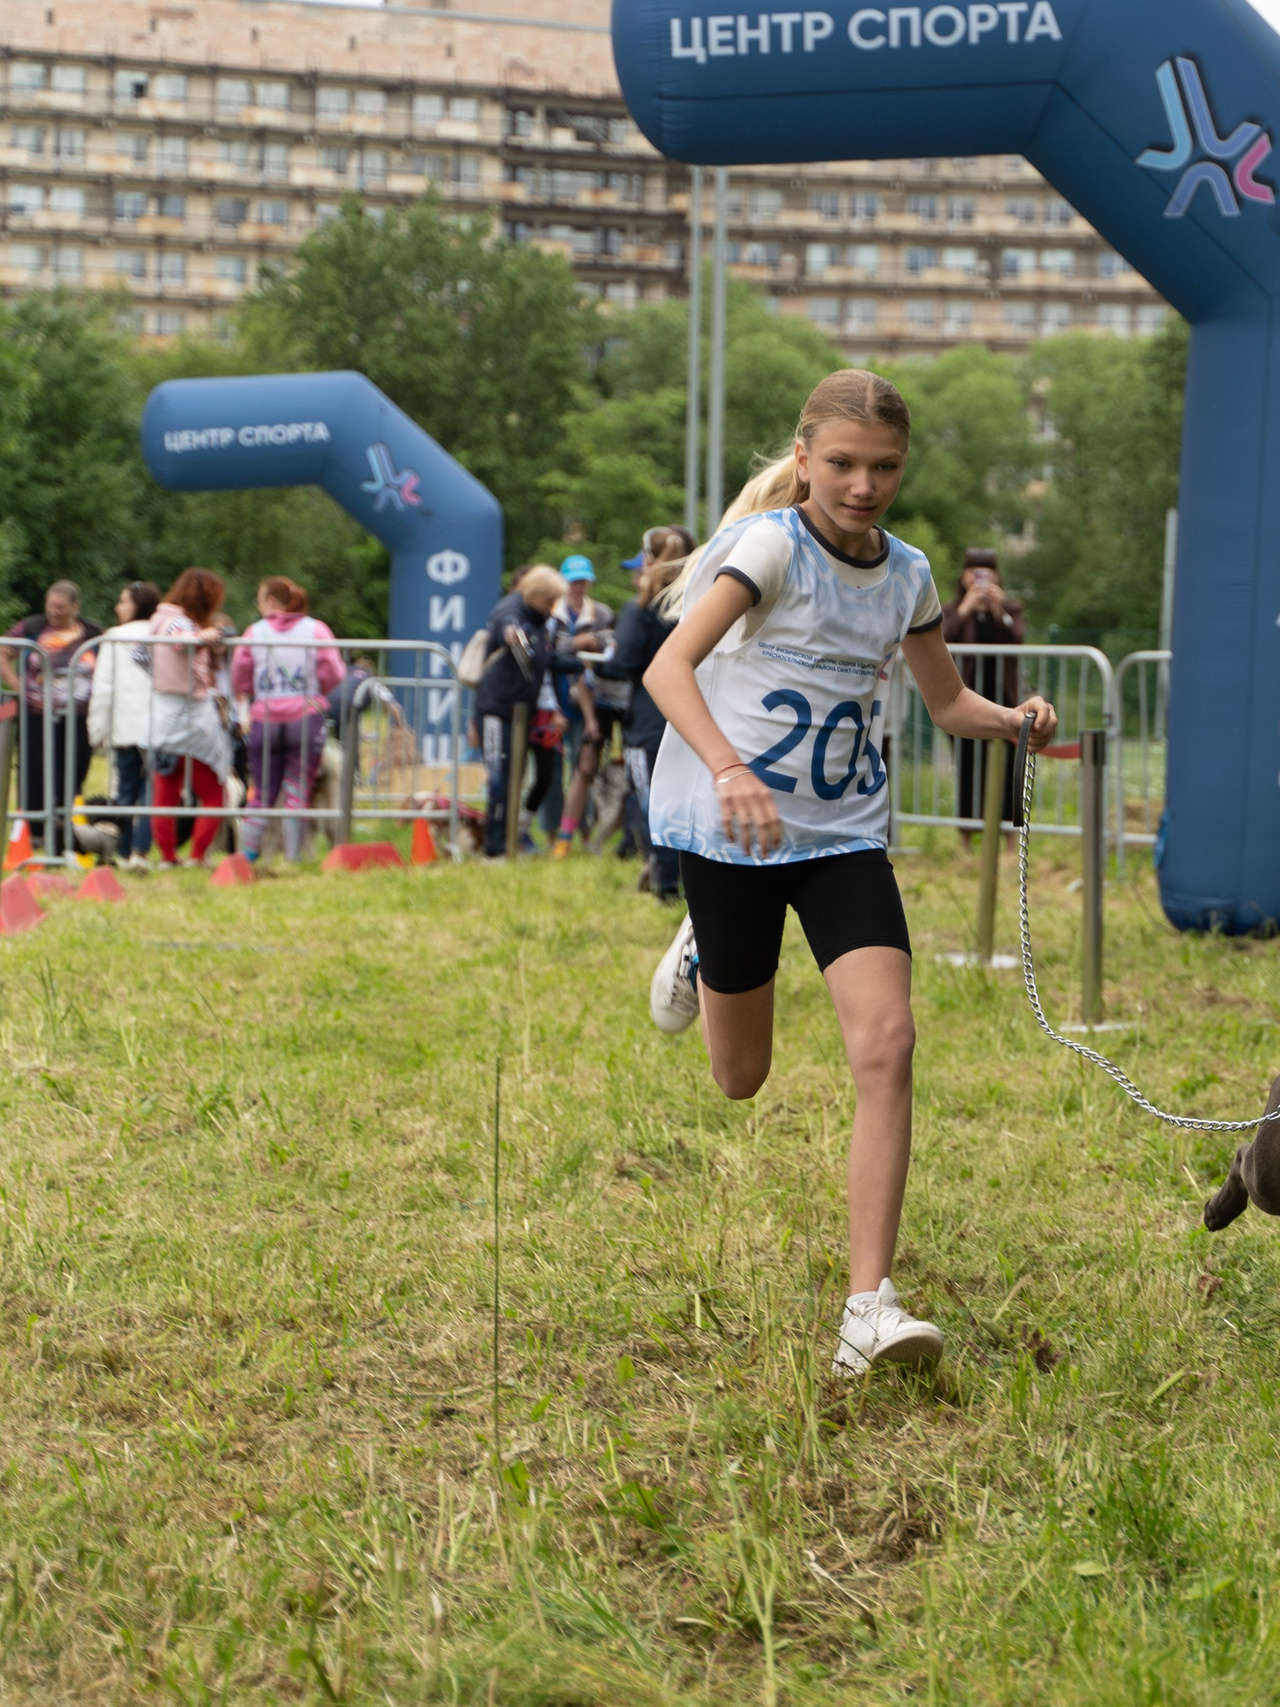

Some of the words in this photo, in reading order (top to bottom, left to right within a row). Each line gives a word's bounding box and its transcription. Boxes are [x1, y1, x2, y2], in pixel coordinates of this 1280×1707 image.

[670, 11, 834, 64] ЦЕНТР
[847, 1, 1063, 50] СПОРТА
[163, 427, 236, 454] ЦЕНТР
[238, 421, 331, 447] СПОРТА
